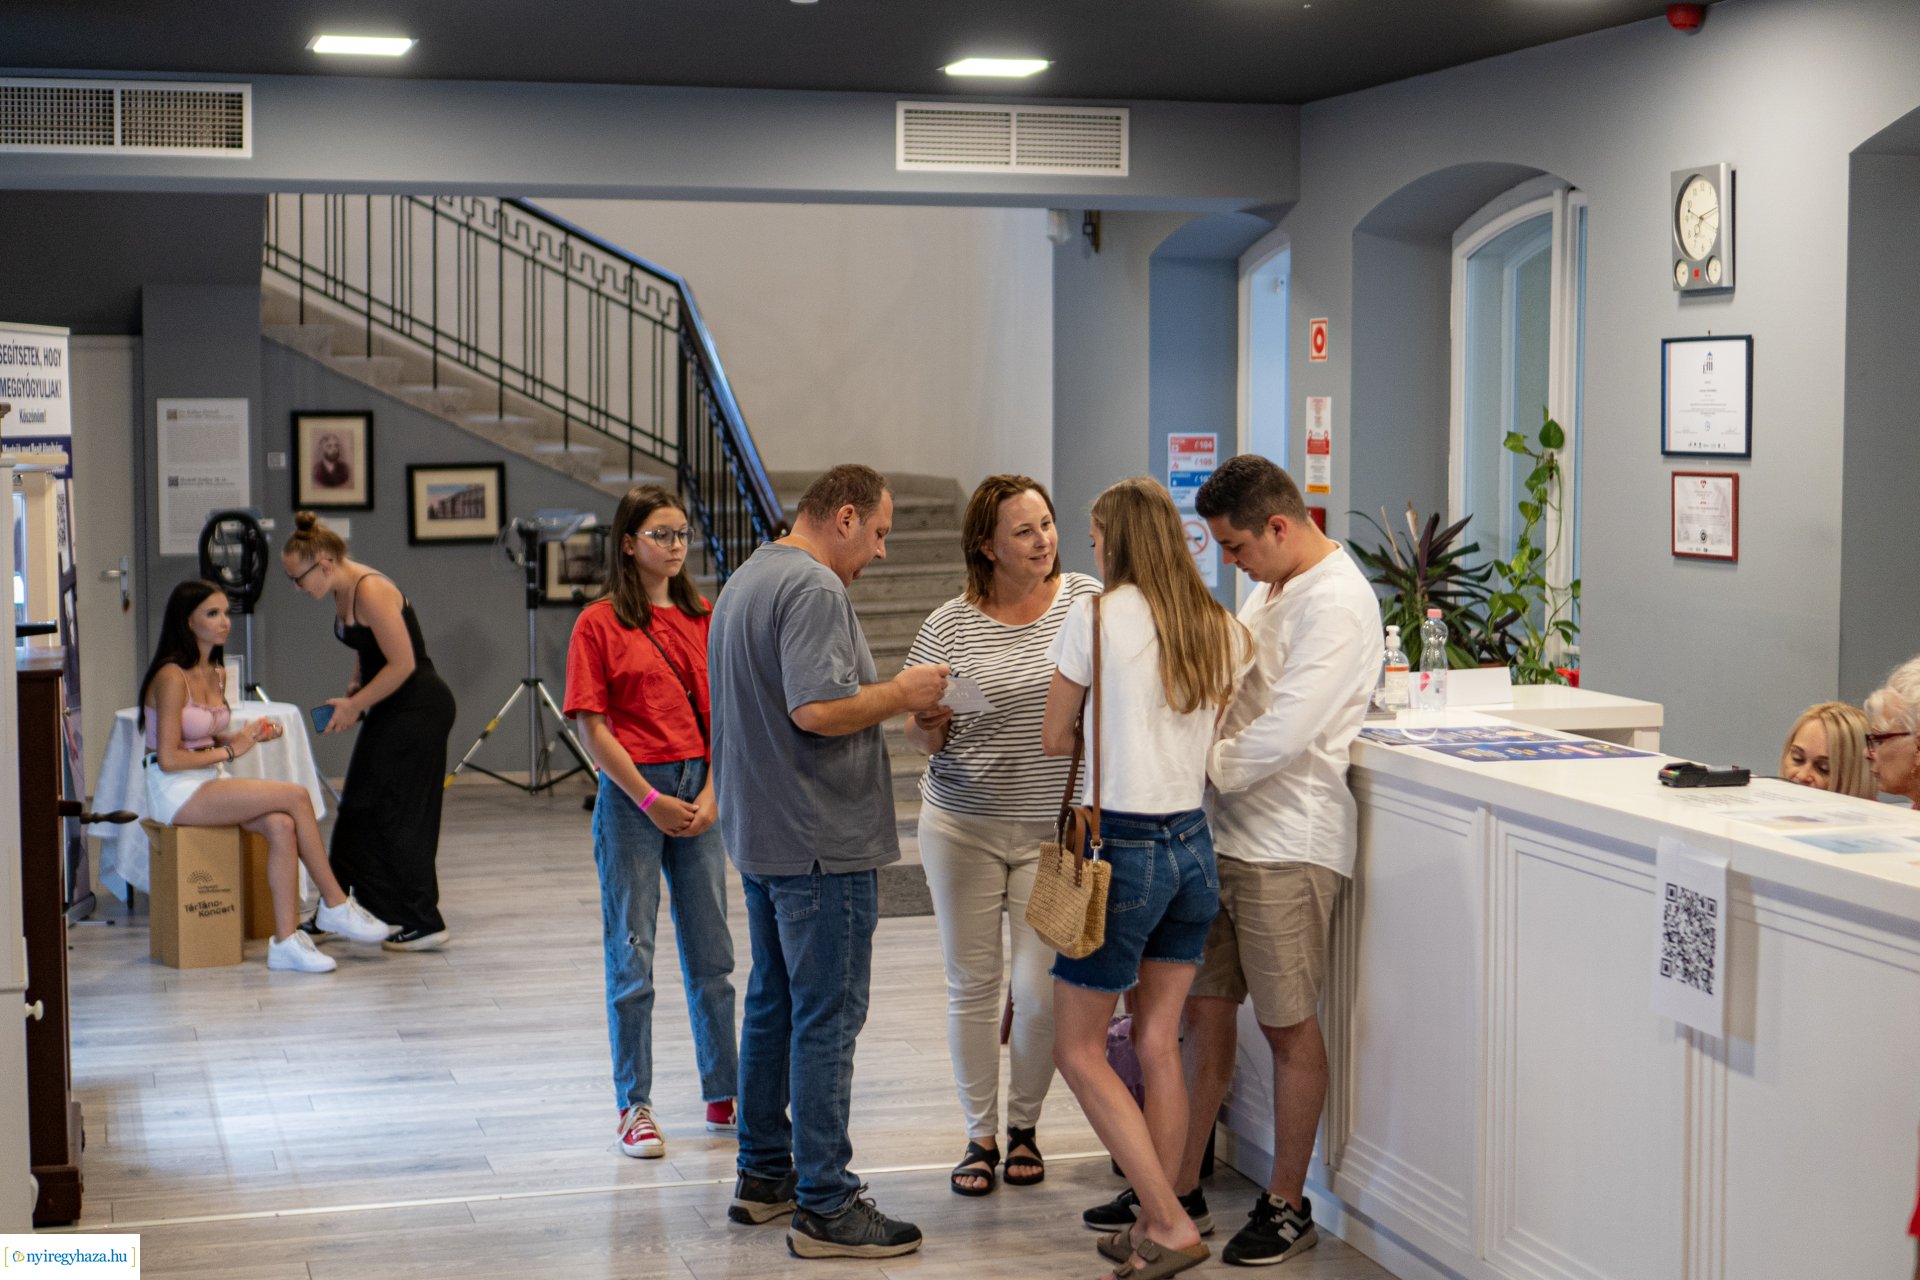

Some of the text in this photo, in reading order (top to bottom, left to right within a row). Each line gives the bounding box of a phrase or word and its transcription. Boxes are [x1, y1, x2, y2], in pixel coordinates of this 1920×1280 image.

[43, 346, 61, 367] HOGY
[0, 371, 61, 398] MEGGYÓGYULJAK!
[19, 408, 46, 424] Köszönöm!
